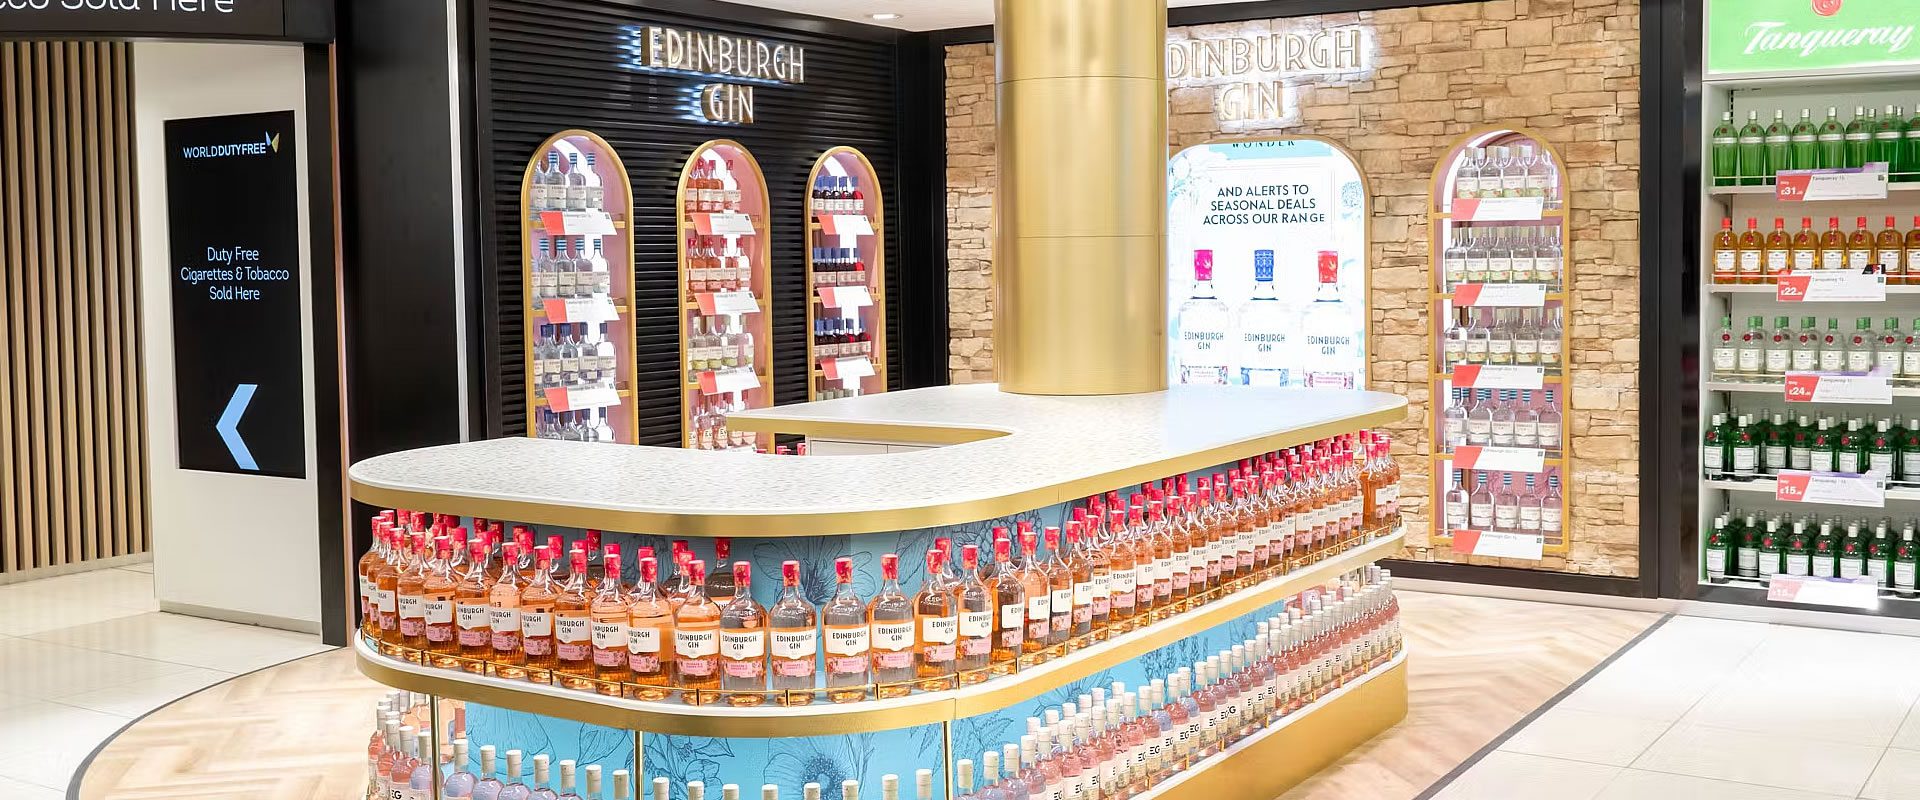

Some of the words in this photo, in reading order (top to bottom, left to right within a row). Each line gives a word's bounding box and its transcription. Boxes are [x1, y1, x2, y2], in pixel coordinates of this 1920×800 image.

[1743, 21, 1915, 57] Tanqueray
[643, 26, 804, 84] EDINBURGH
[1168, 30, 1361, 79] DINBURGH
[705, 83, 754, 123] GIN
[1220, 81, 1283, 121] GIN
[1217, 186, 1242, 198] AND
[1246, 185, 1289, 197] ALERTS
[1293, 184, 1309, 195] TO
[1211, 200, 1274, 211] SEASONAL
[1277, 198, 1316, 210] DEALS
[1203, 213, 1249, 225] ACROSS
[1252, 213, 1278, 224] OUR
[1281, 212, 1325, 223] RANGE
[207, 246, 232, 265] Duty
[235, 246, 259, 261] Free
[180, 267, 233, 285] Cigarettes
[235, 266, 243, 281] &
[244, 266, 289, 281] Tobacco
[209, 285, 233, 300] Sold
[235, 286, 260, 300] Here
[1184, 331, 1224, 341] EDINBURGH
[1244, 333, 1286, 342] EDINBURGH
[1307, 335, 1350, 345] EDINBURGH
[1197, 341, 1211, 350] GIN
[1257, 343, 1272, 352] GIN
[1321, 346, 1336, 355] GIN
[677, 633, 712, 641] EDINBURGH
[722, 634, 757, 643] EDINBURGH
[776, 633, 812, 643] EDINBURGH
[832, 630, 867, 640] EDINBURGH
[890, 634, 903, 642] GIN
[1189, 723, 1200, 733] EG
[1180, 731, 1190, 741] EG
[1149, 745, 1160, 755] EG
